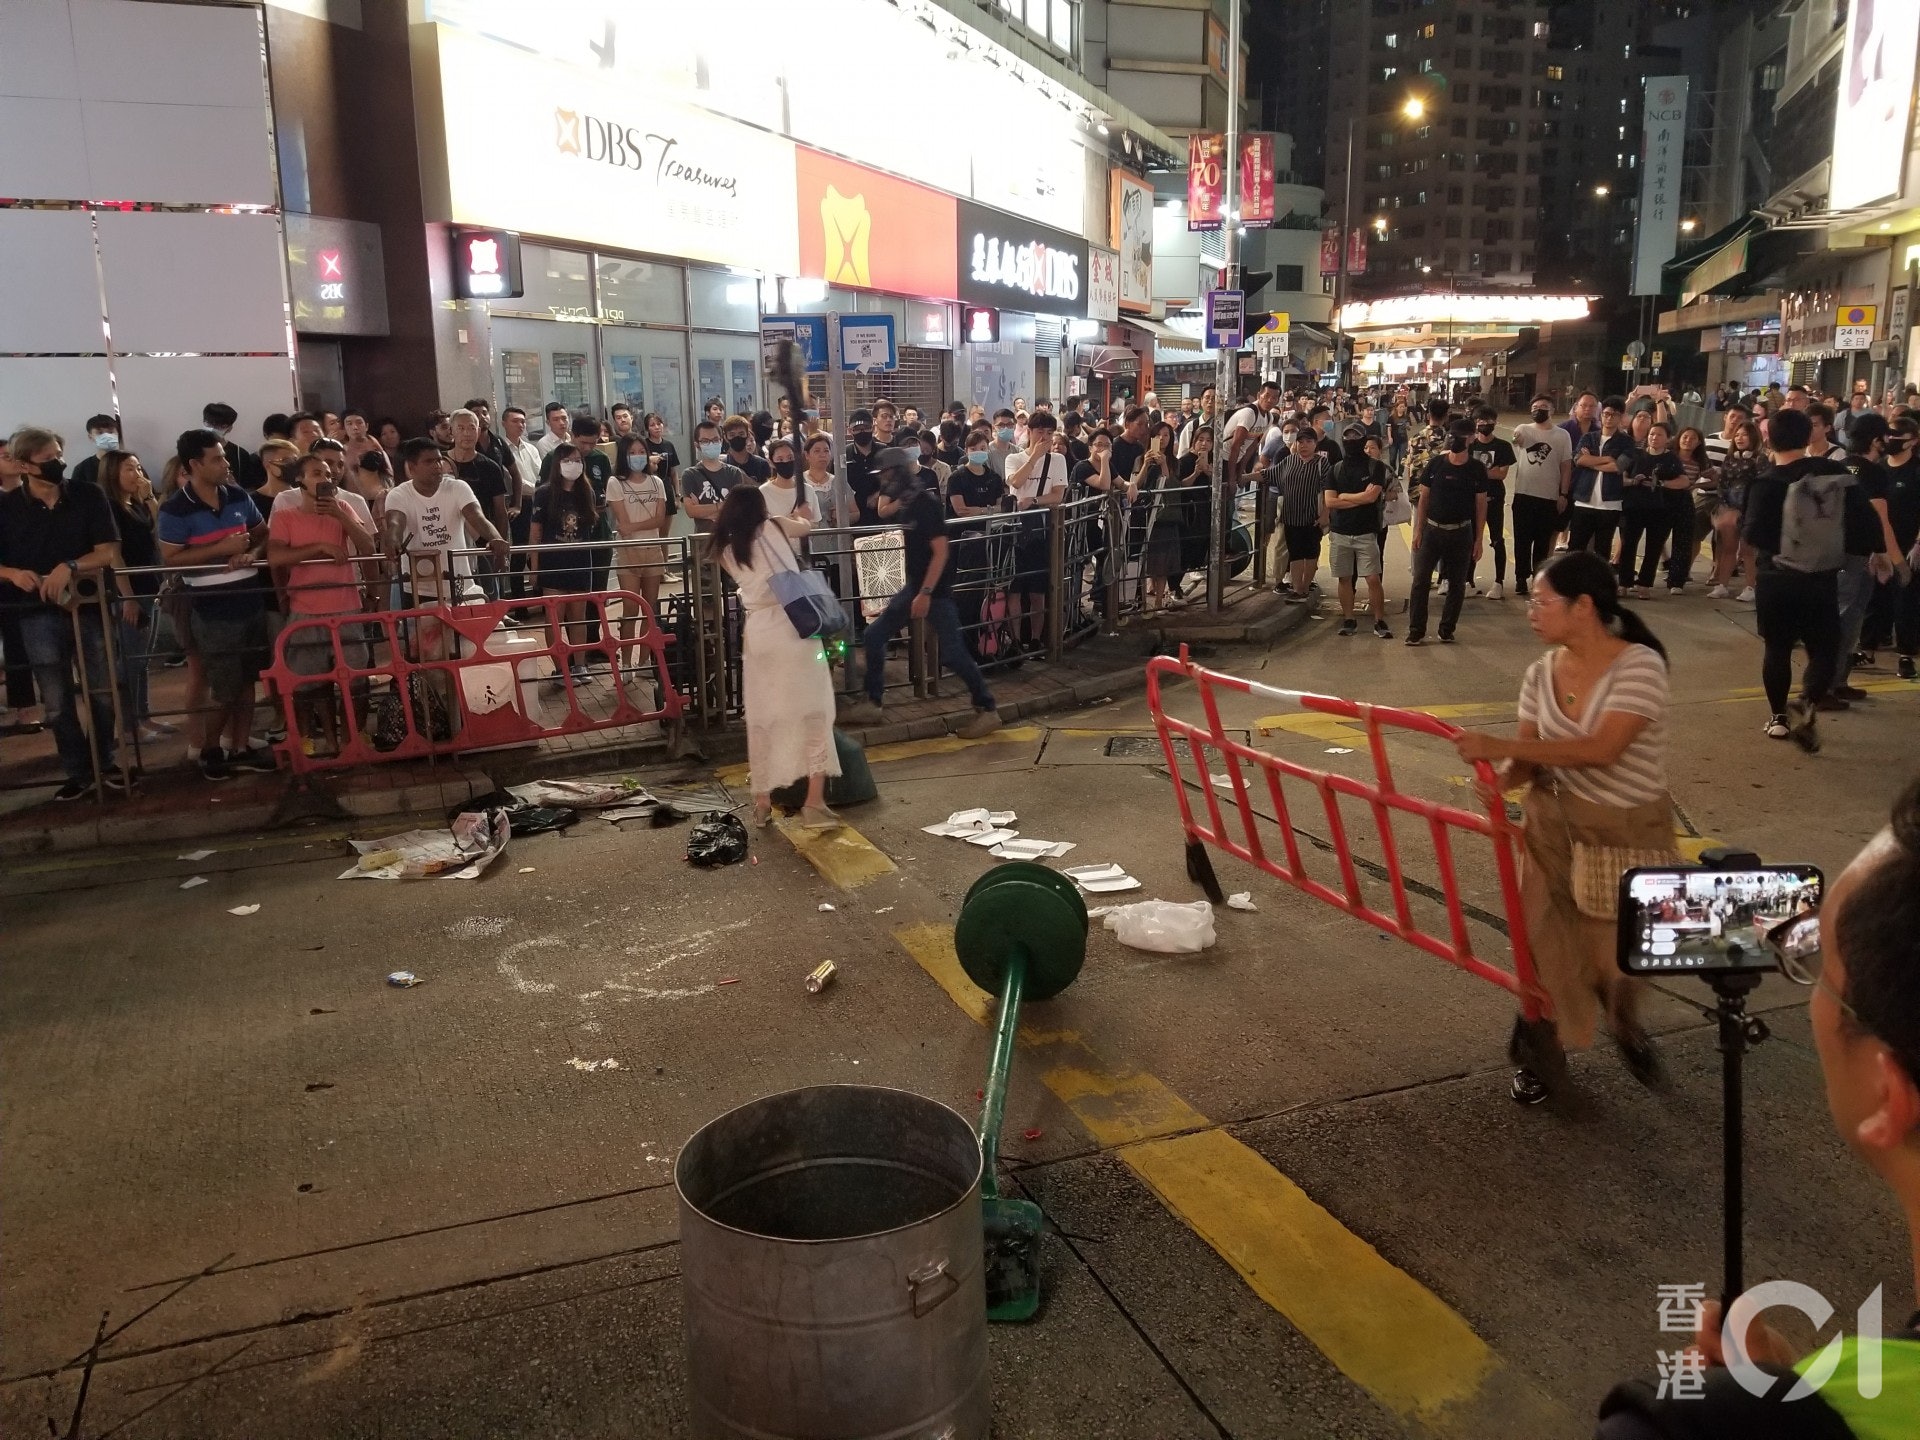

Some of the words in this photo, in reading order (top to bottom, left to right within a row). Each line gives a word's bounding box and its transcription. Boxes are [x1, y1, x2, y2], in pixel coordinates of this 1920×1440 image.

[1648, 109, 1682, 121] NCB
[584, 115, 642, 171] DBS
[645, 133, 738, 198] Treasures
[1192, 162, 1221, 187] 70
[1652, 128, 1671, 221] 南洋商業銀行
[1322, 240, 1338, 254] 70
[1840, 328, 1852, 336] 24
[1854, 328, 1869, 336] hrs
[1842, 337, 1865, 347] 全日
[422, 513, 441, 522] really
[422, 524, 435, 532] not
[427, 525, 447, 537] good
[436, 532, 452, 541] with
